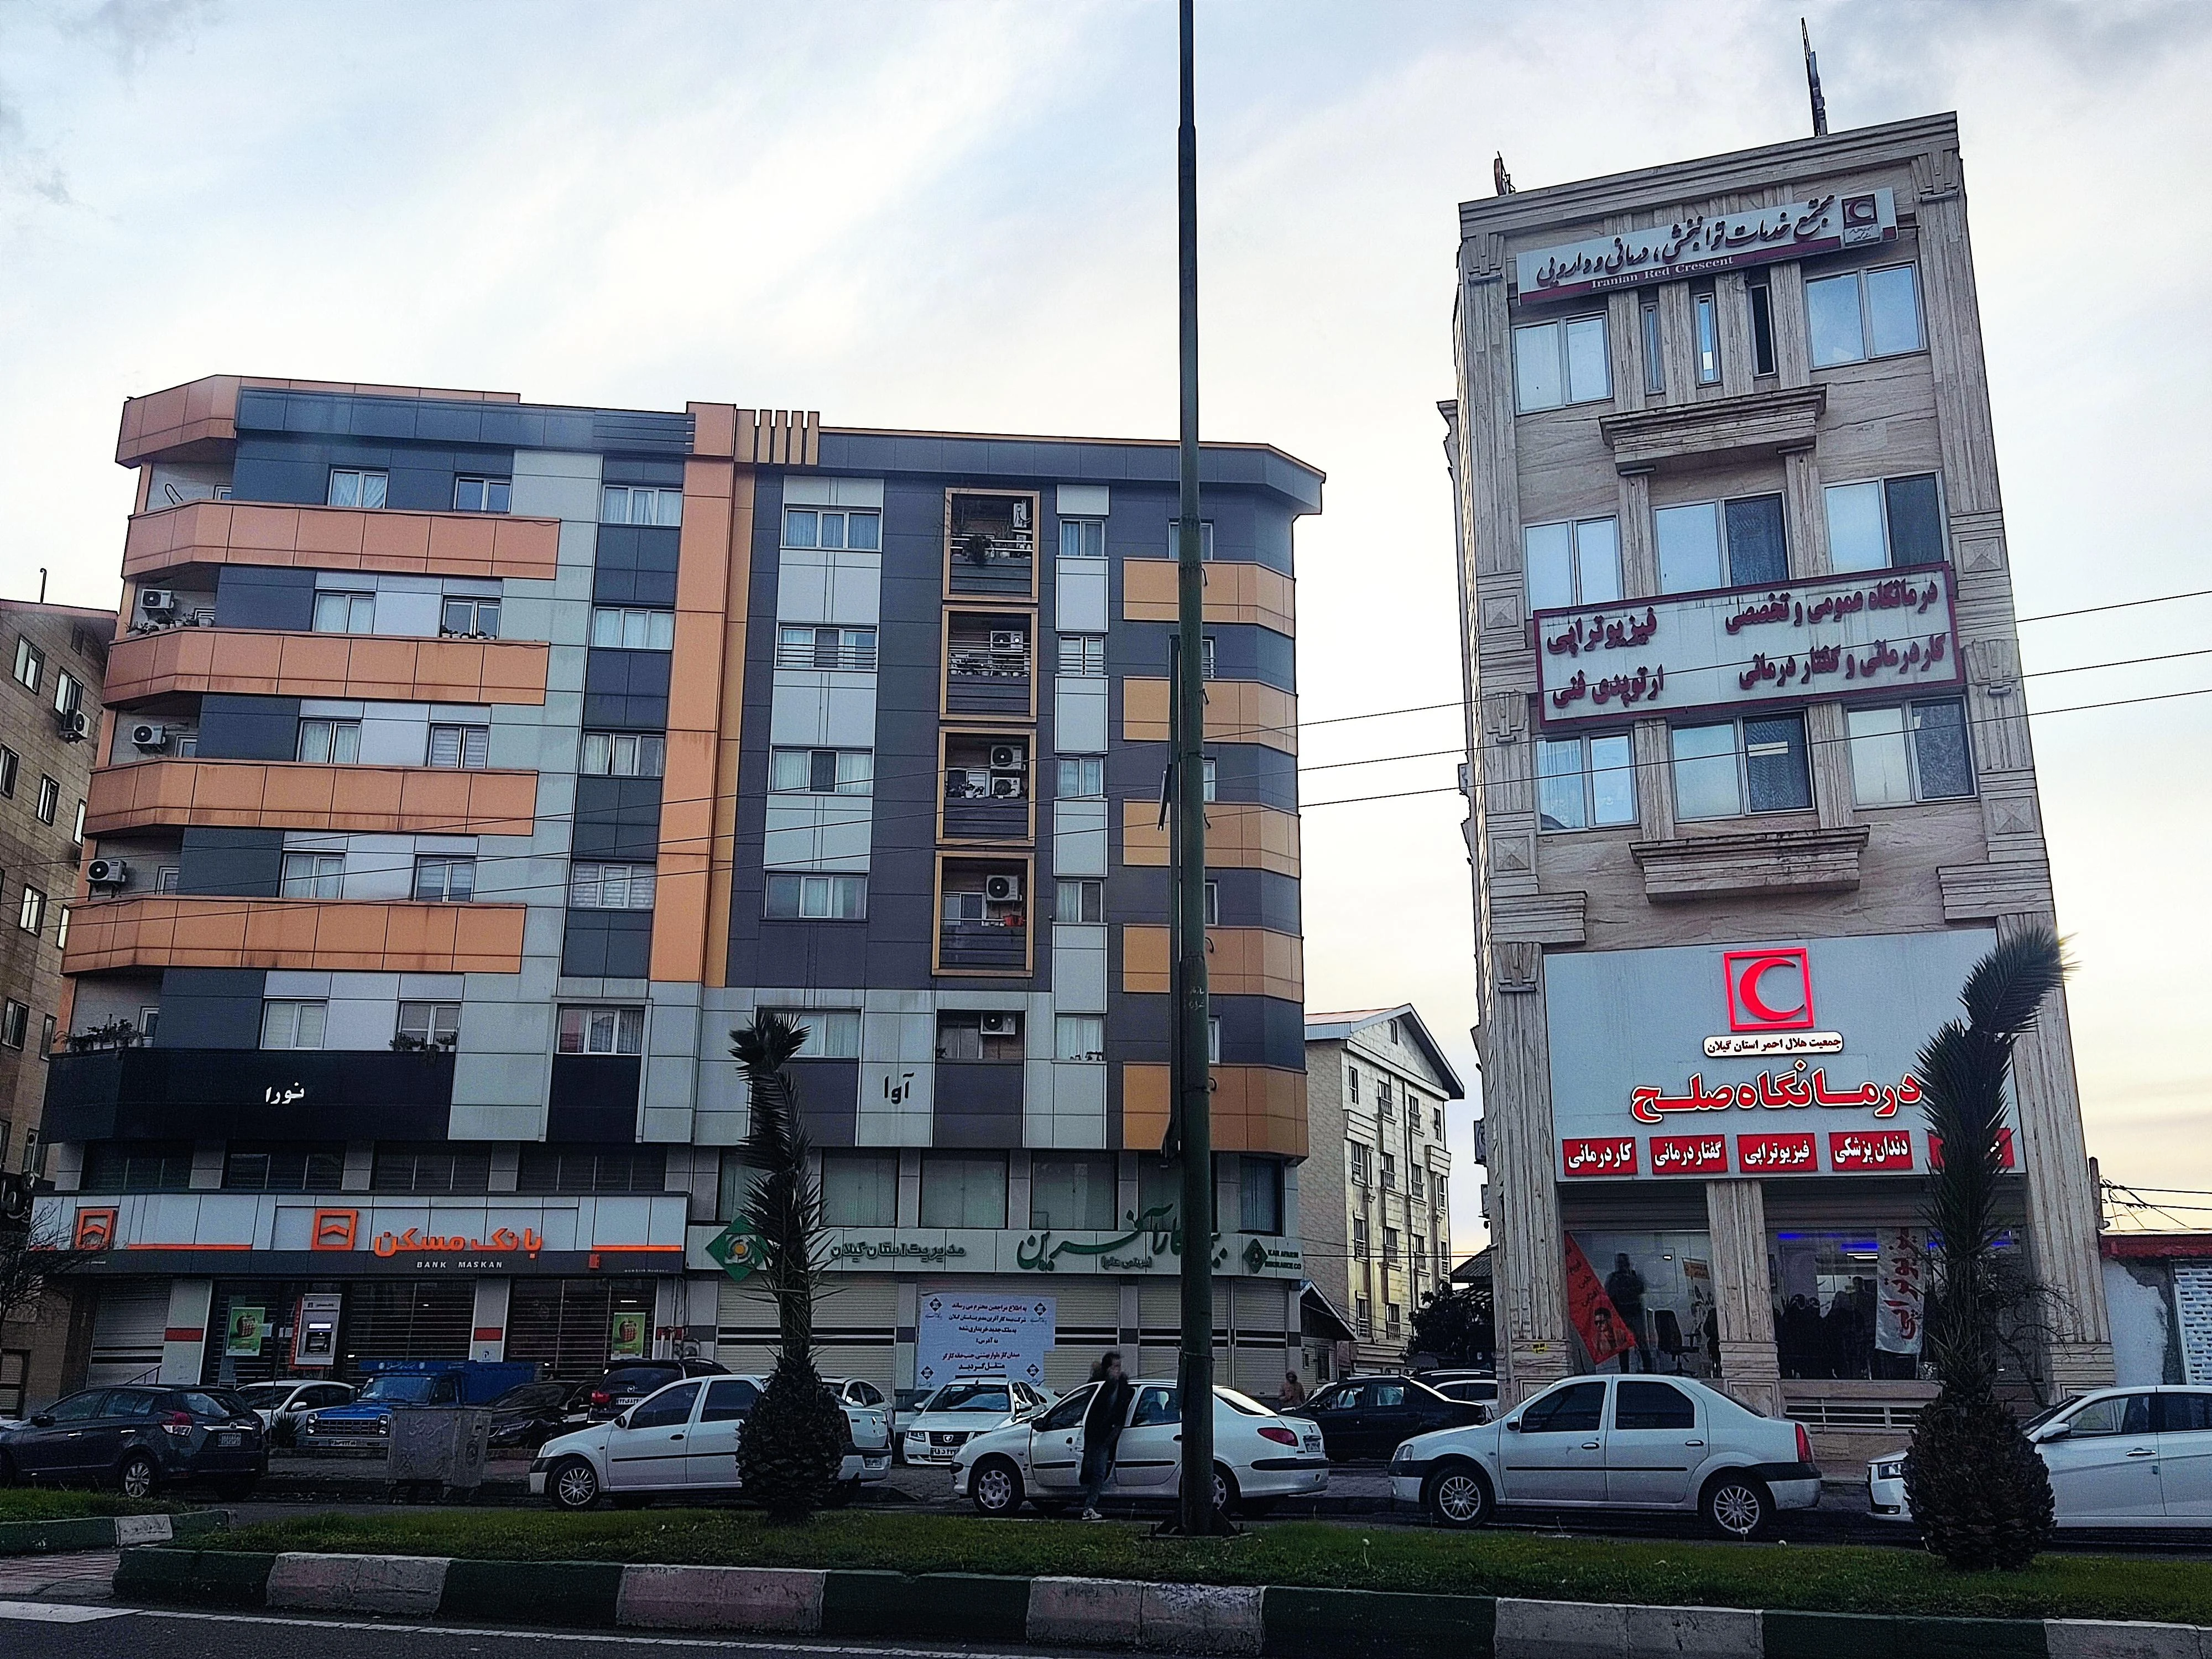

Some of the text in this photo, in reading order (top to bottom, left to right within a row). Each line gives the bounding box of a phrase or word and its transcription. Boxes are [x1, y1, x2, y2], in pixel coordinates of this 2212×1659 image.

[1725, 212, 1791, 248] خدمات
[1793, 195, 1835, 242] مجتمع
[1537, 252, 1592, 288] دارویی
[1594, 256, 1603, 273] و
[1605, 237, 1649, 274] درمانی
[1592, 257, 1734, 289] Iranian Red Crescent
[1725, 578, 1938, 634] درمانگاه عمومی و تخصصی
[1547, 607, 1657, 658] فیزیوتراپی
[1845, 654, 1855, 680] و
[1553, 664, 1664, 709] ارتوپدی فنی
[1707, 1038, 1841, 1053] جمعیت هلال احمر استان گیلان
[265, 1082, 305, 1104] نورا
[884, 1072, 915, 1104] آوا
[1631, 1059, 1923, 1123] درمانگاه صلح
[1744, 1140, 1810, 1165] فیزیوتراپی
[1835, 1135, 1908, 1164] دندان پزشکی
[374, 1228, 542, 1259] بانک مسکن
[831, 1241, 966, 1263] مدیریت استان گیلان
